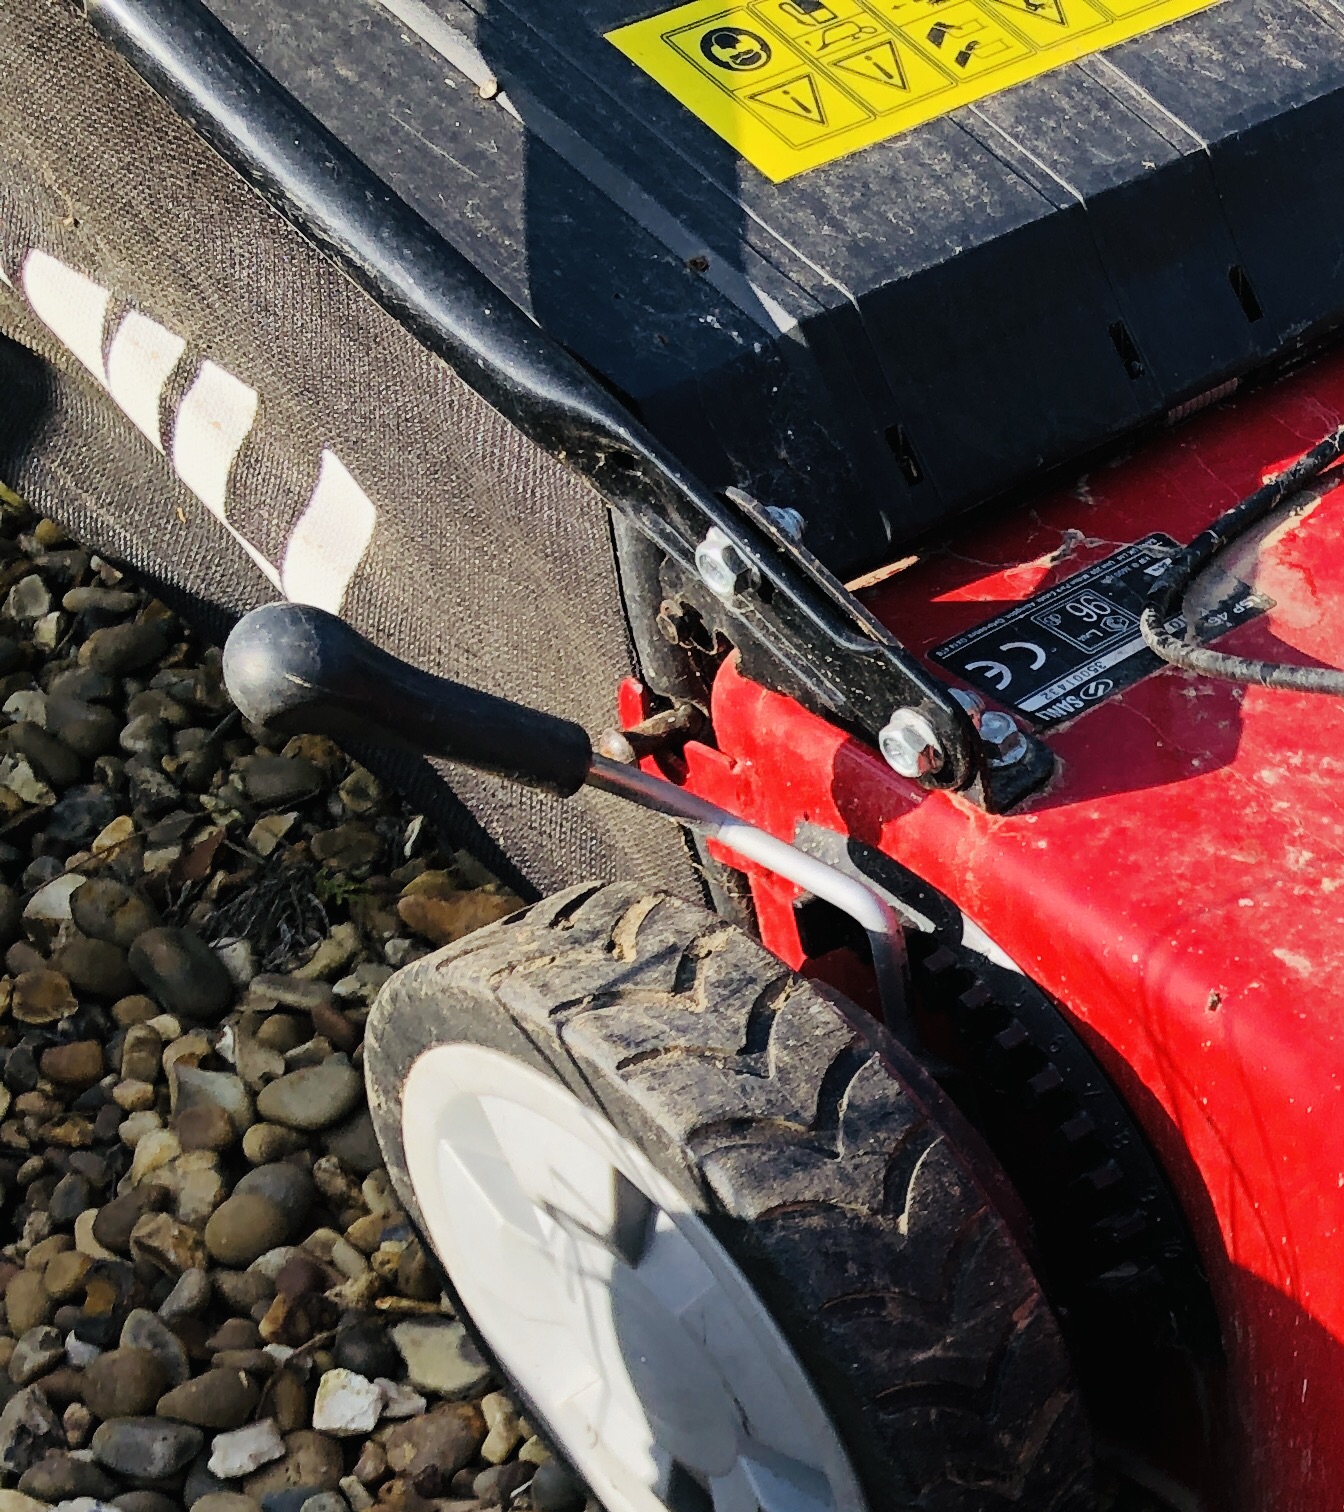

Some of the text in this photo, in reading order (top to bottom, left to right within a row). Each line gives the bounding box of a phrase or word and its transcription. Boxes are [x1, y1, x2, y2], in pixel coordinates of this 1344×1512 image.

[1066, 594, 1111, 629] 96
[1205, 610, 1233, 626] 46
[1036, 660, 1109, 700] 35001432
[1034, 693, 1086, 723] SANLI
